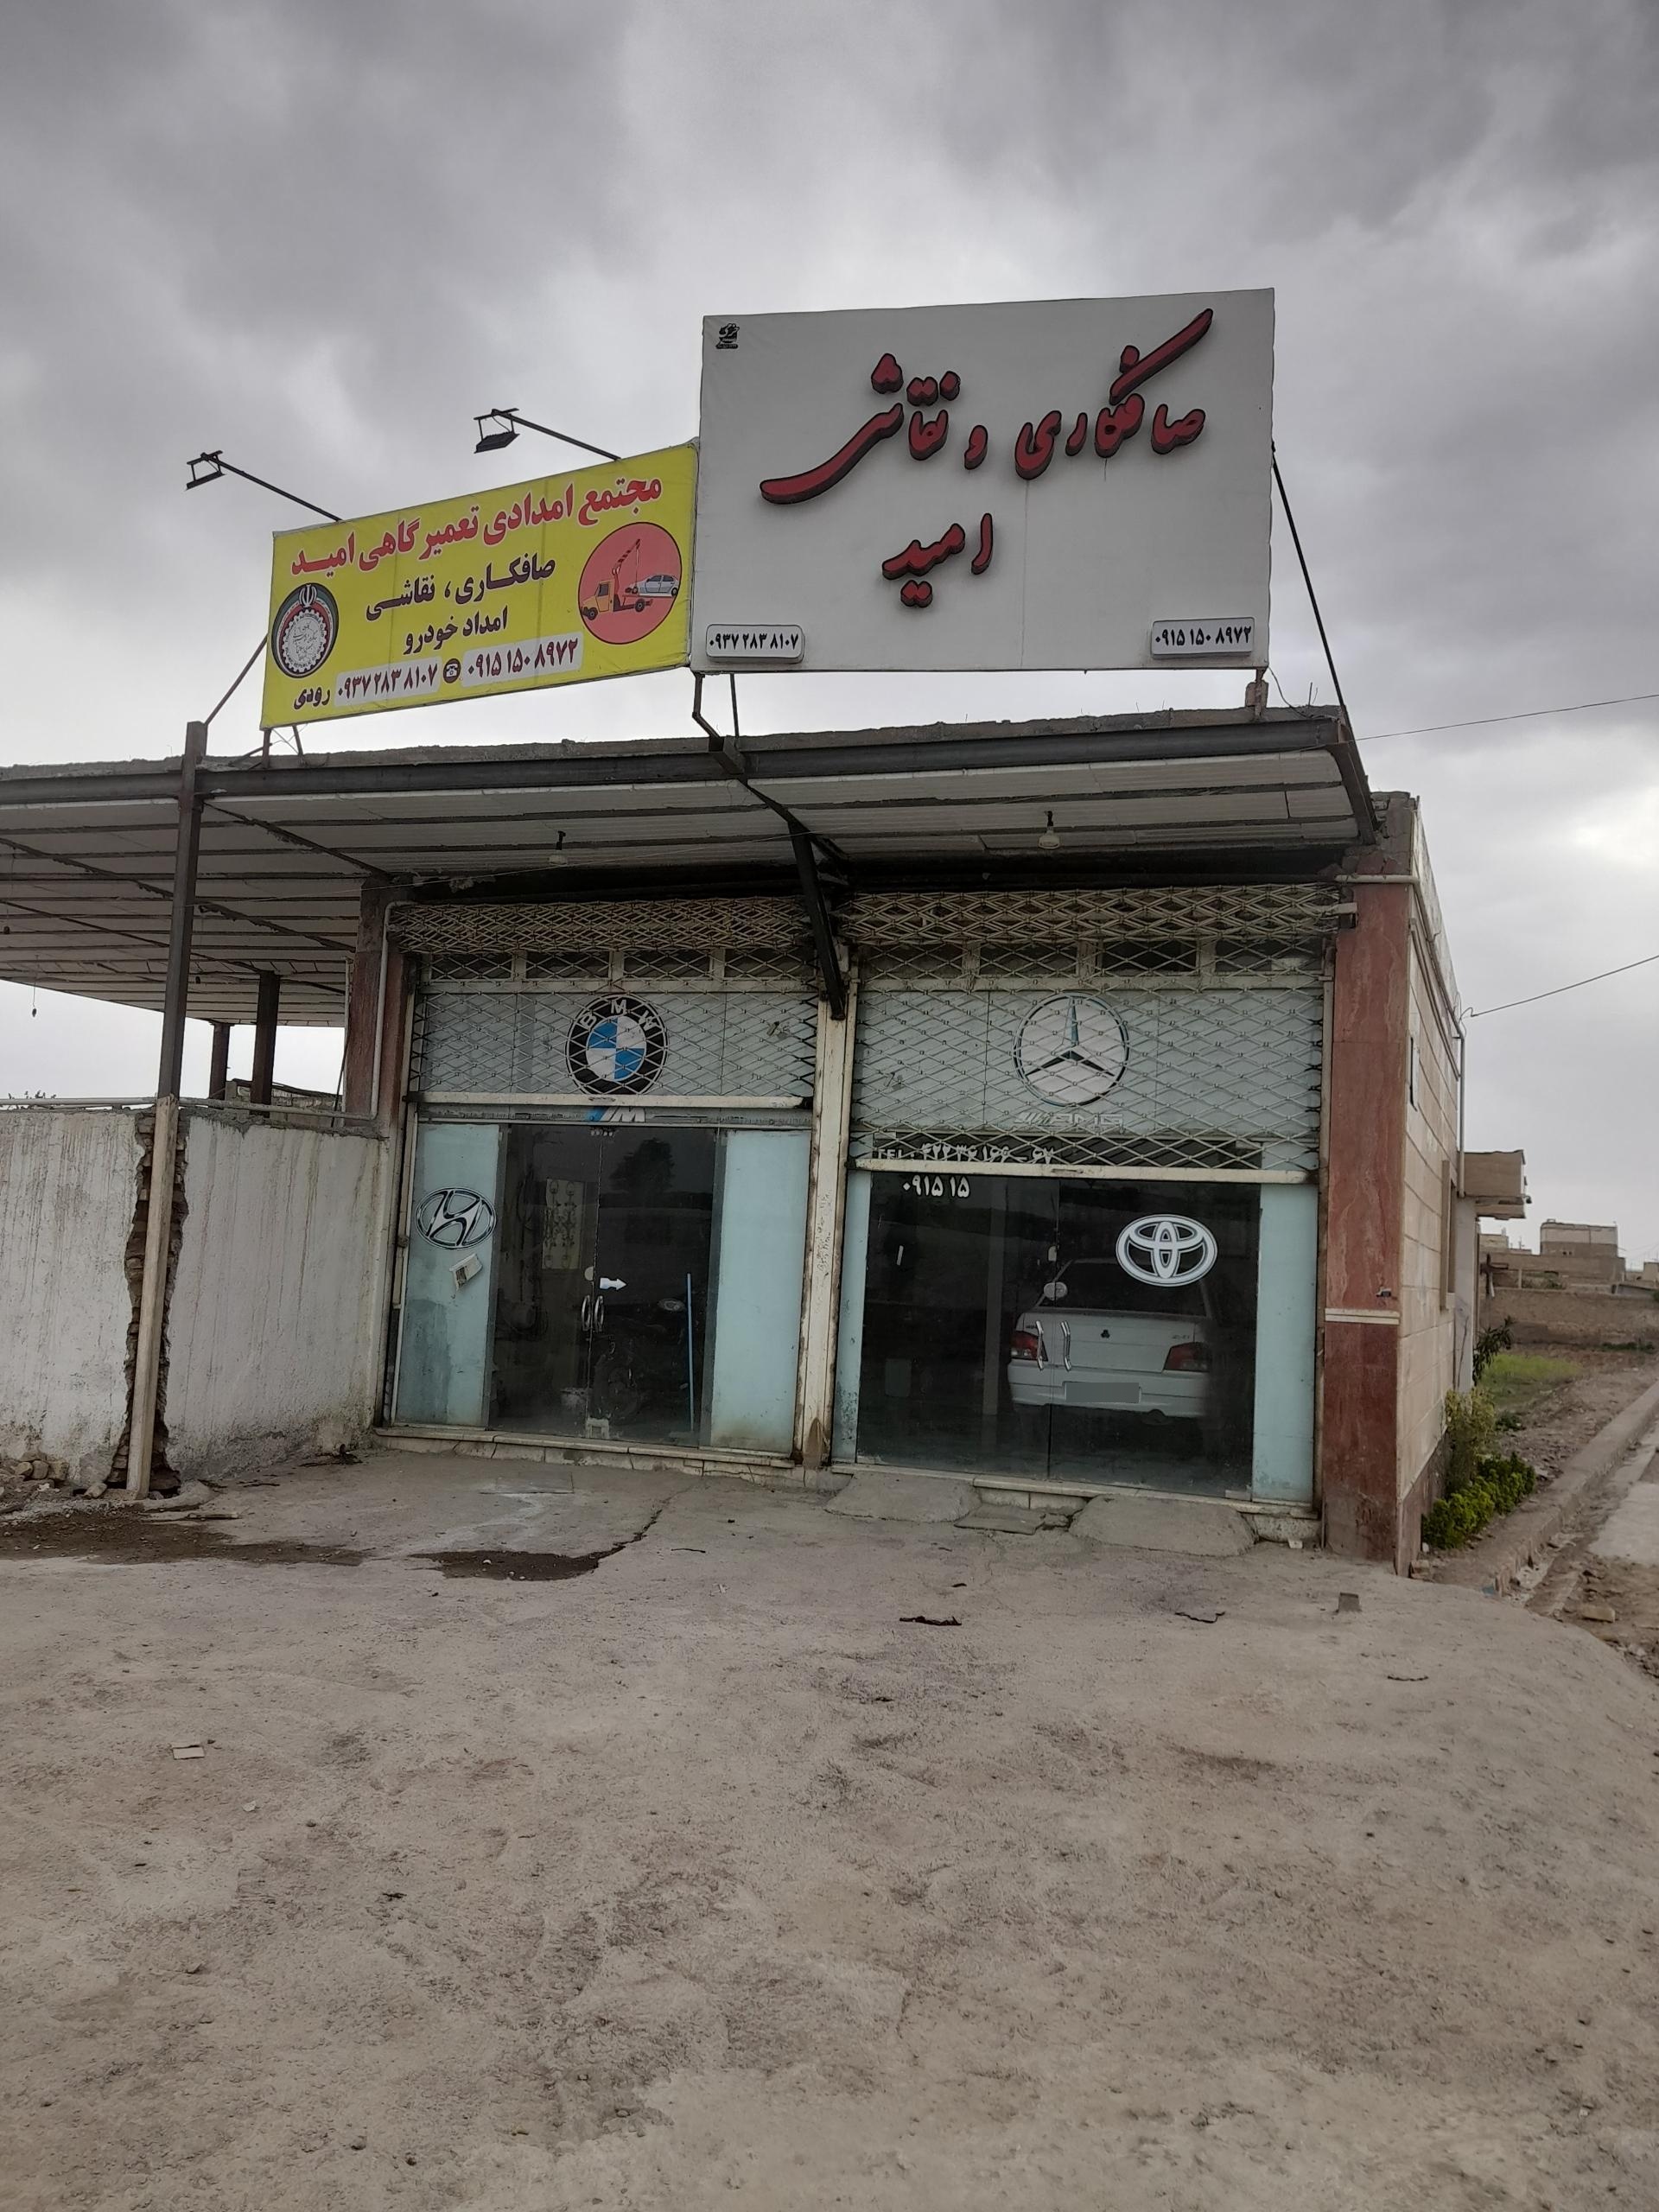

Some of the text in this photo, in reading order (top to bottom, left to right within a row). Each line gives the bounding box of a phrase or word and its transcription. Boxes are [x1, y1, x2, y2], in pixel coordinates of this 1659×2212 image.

[963, 424, 988, 470] و
[482, 482, 574, 546] امدادی
[578, 478, 662, 526] مجتمع
[290, 531, 355, 578] امید
[454, 551, 556, 605] صافکاری
[880, 512, 994, 607] امید
[365, 574, 436, 621] نقاشی
[403, 604, 509, 656] امداد خودرو
[579, 999, 659, 1032] BMW
